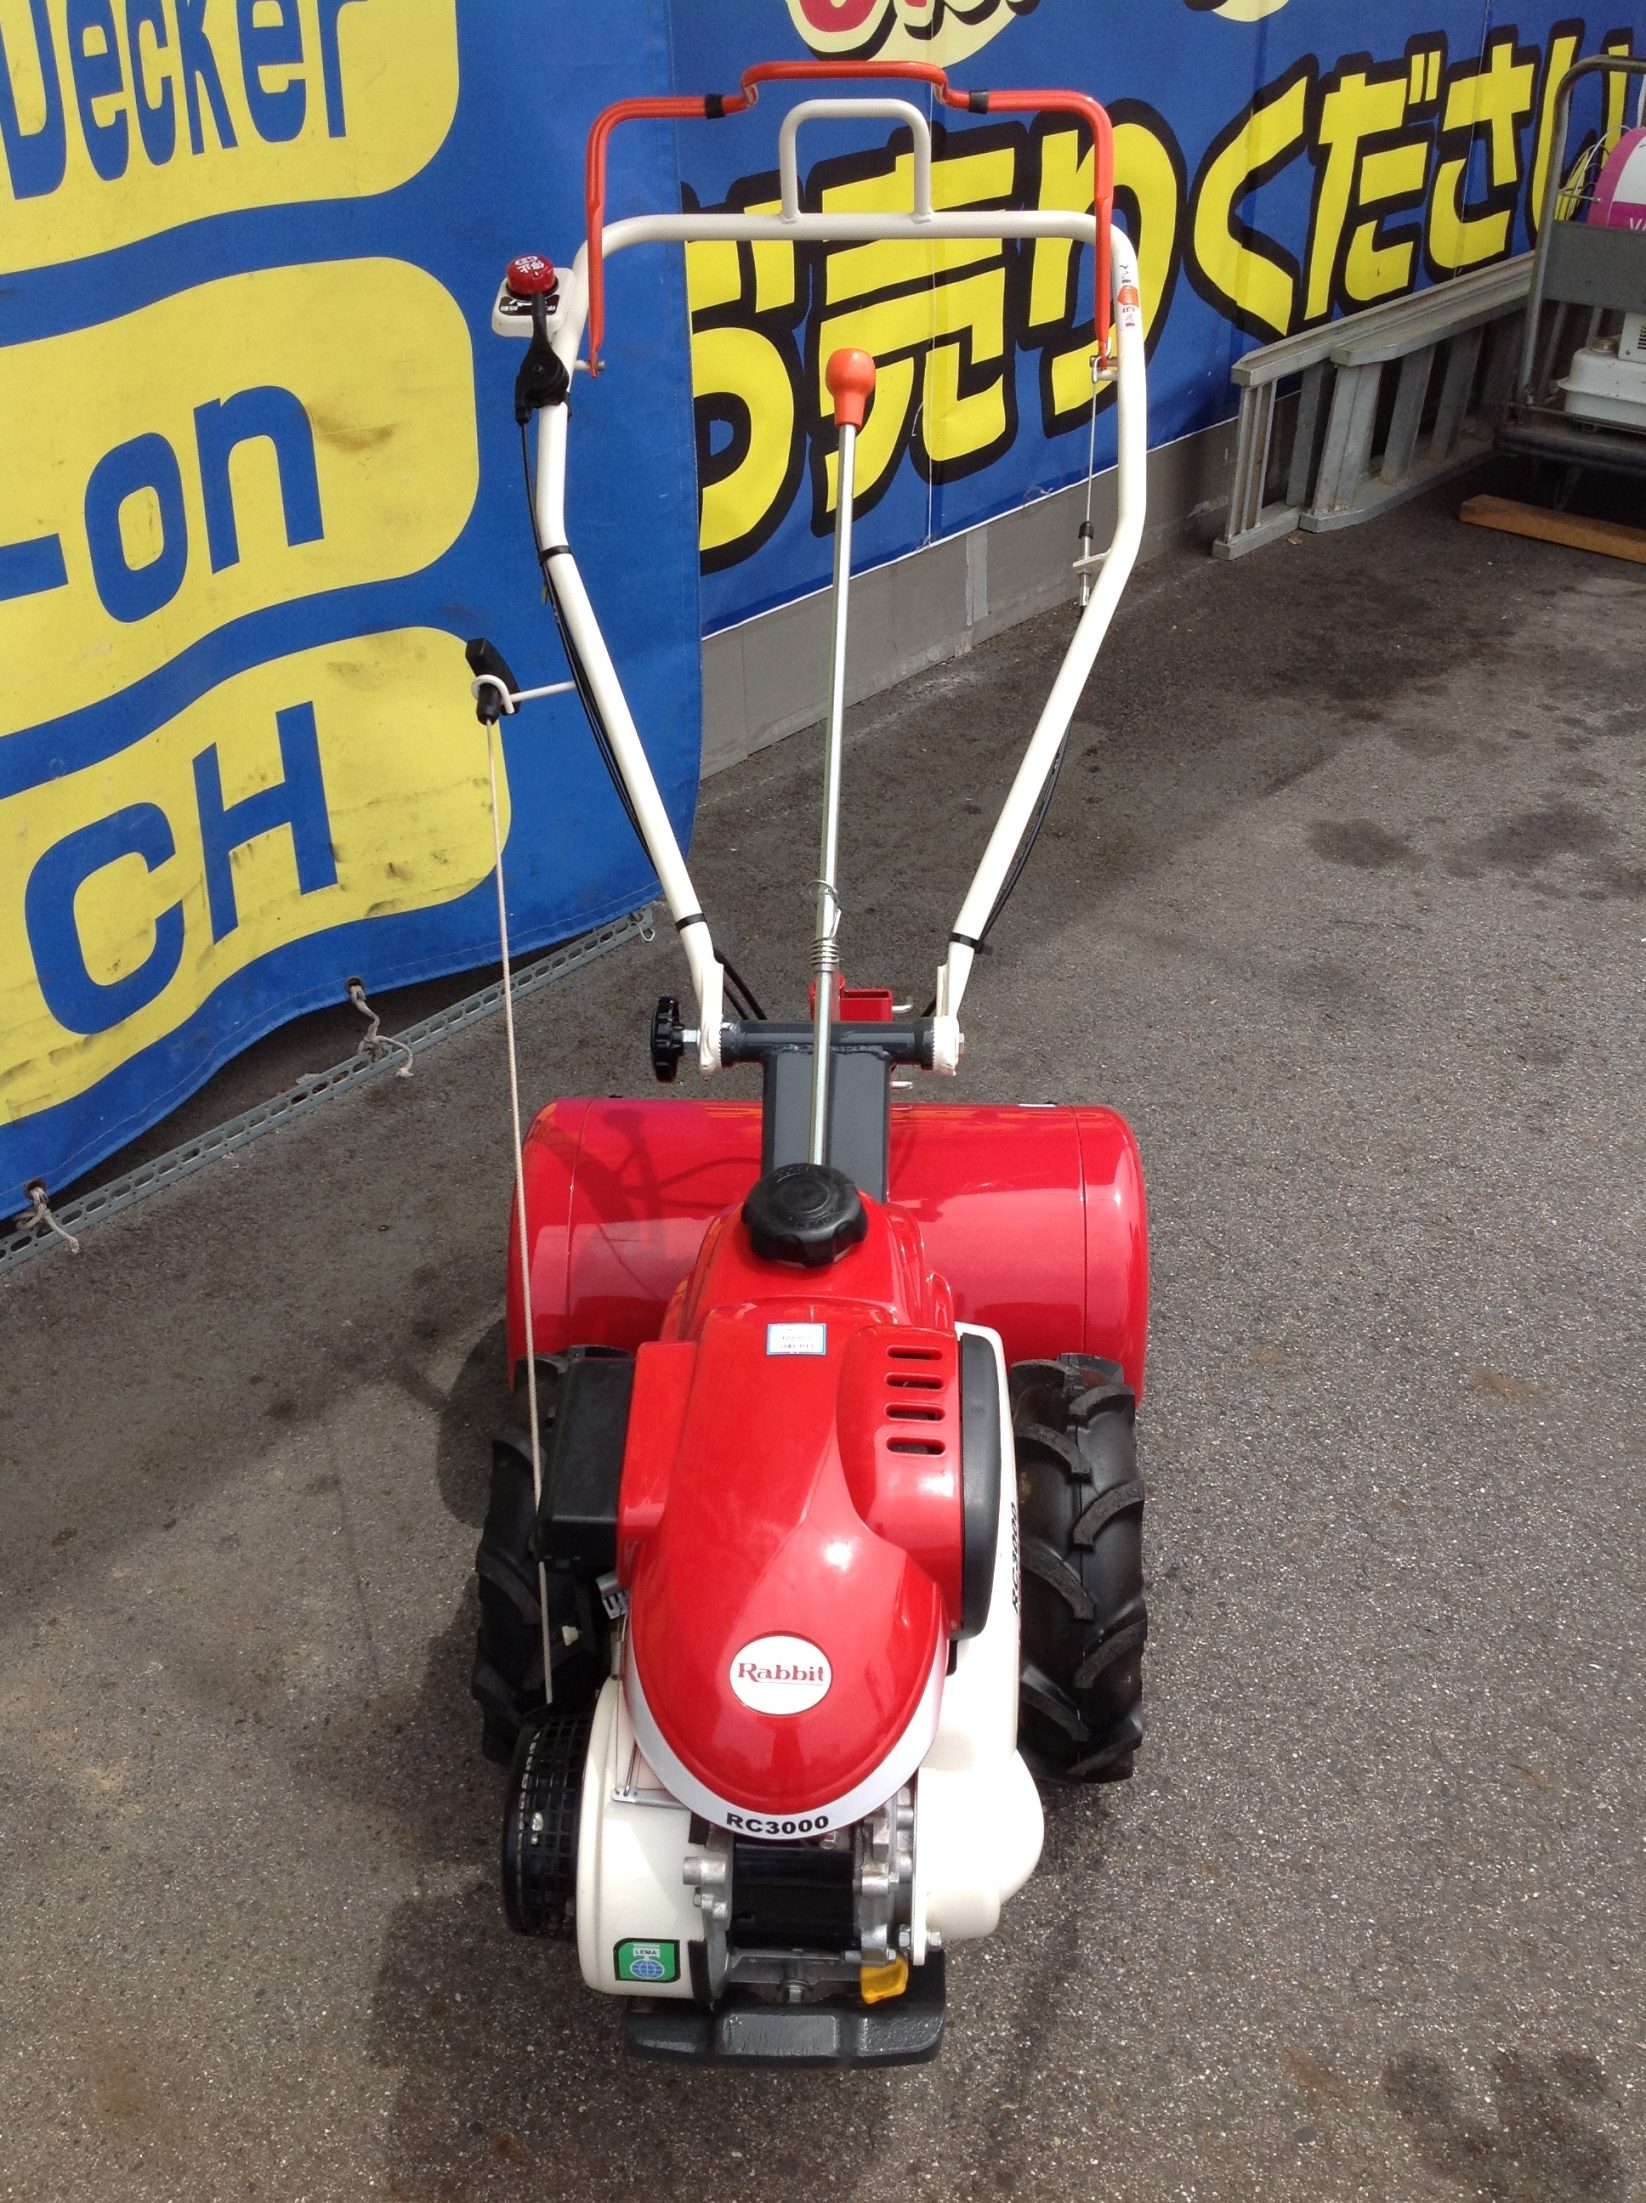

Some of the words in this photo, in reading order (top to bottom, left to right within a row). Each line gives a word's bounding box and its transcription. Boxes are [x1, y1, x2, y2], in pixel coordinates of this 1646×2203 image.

[25, 700, 338, 1035] CH
[738, 1662, 824, 1684] Rabbit
[726, 1812, 829, 1835] RC3000
